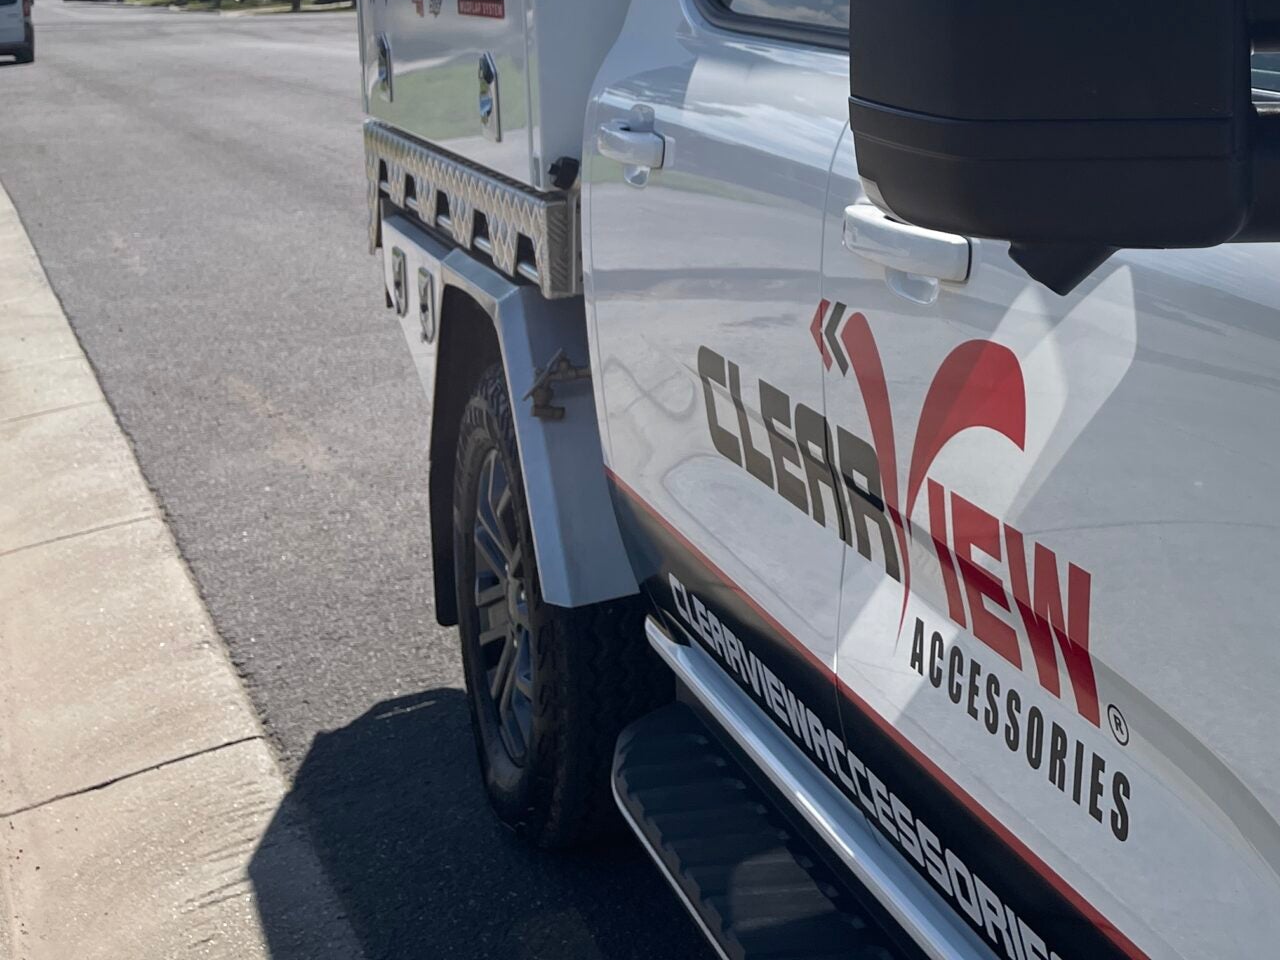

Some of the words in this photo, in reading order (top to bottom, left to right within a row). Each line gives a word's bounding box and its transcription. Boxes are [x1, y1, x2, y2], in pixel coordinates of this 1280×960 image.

[697, 310, 1102, 730] CLEARVIEW
[669, 572, 1064, 960] CLEARVIEWACCESSORIE
[910, 616, 1132, 843] ACCESSORIES
